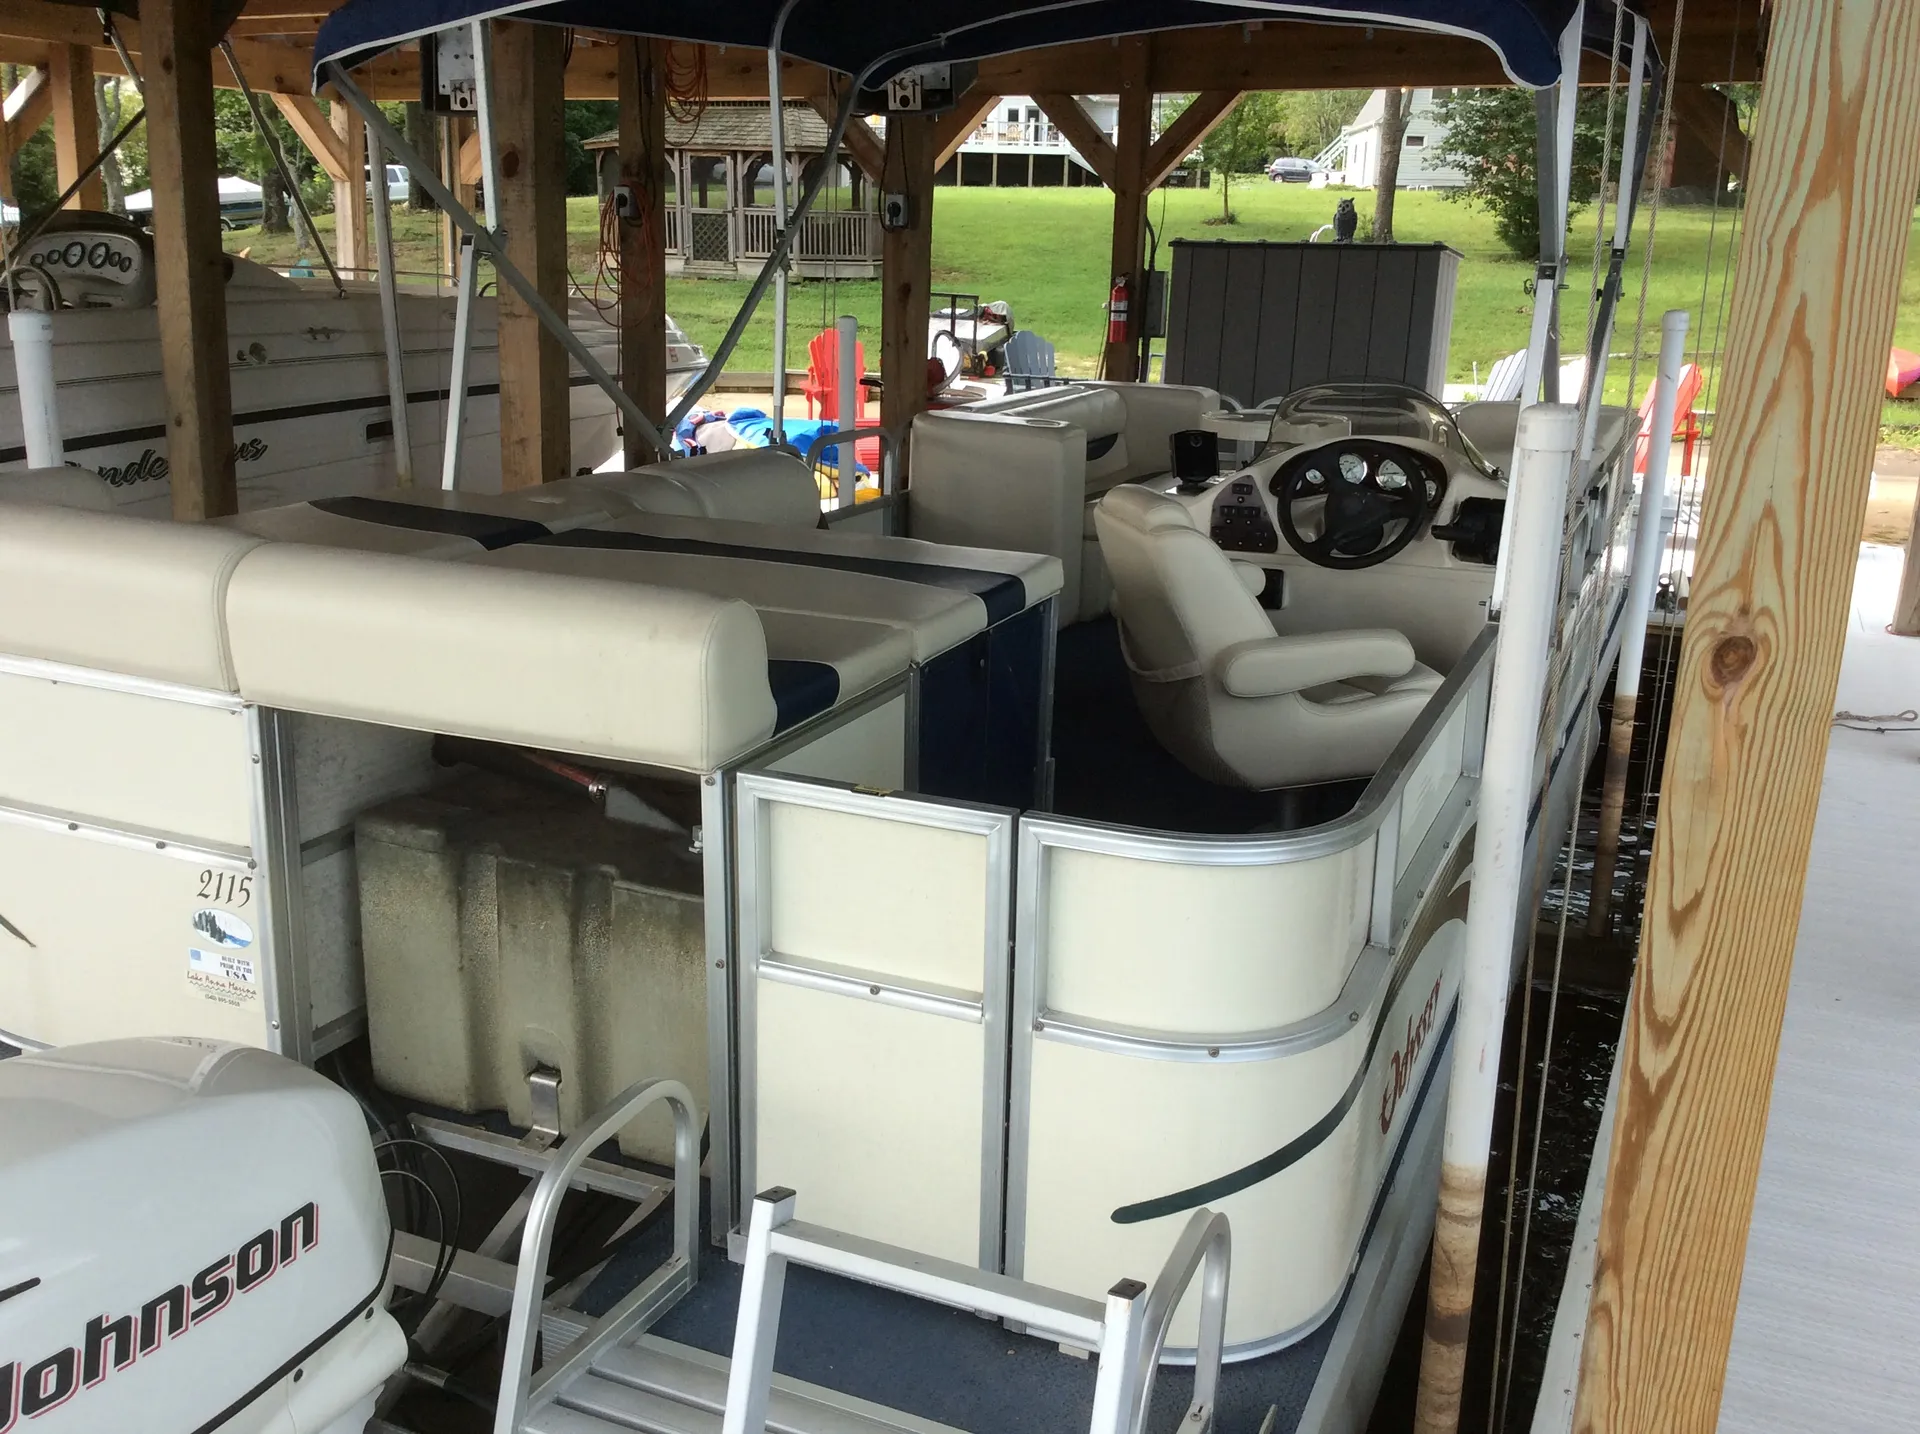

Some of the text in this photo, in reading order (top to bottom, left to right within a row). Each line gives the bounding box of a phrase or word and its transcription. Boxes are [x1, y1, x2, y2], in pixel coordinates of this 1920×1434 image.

[197, 869, 253, 908] 2115
[219, 961, 253, 975] PRIDE IN THE
[221, 955, 251, 967] BUILT WITH
[225, 969, 248, 982] USA
[187, 970, 203, 983] Lake
[204, 974, 226, 988] Anna
[228, 980, 257, 996] Marina
